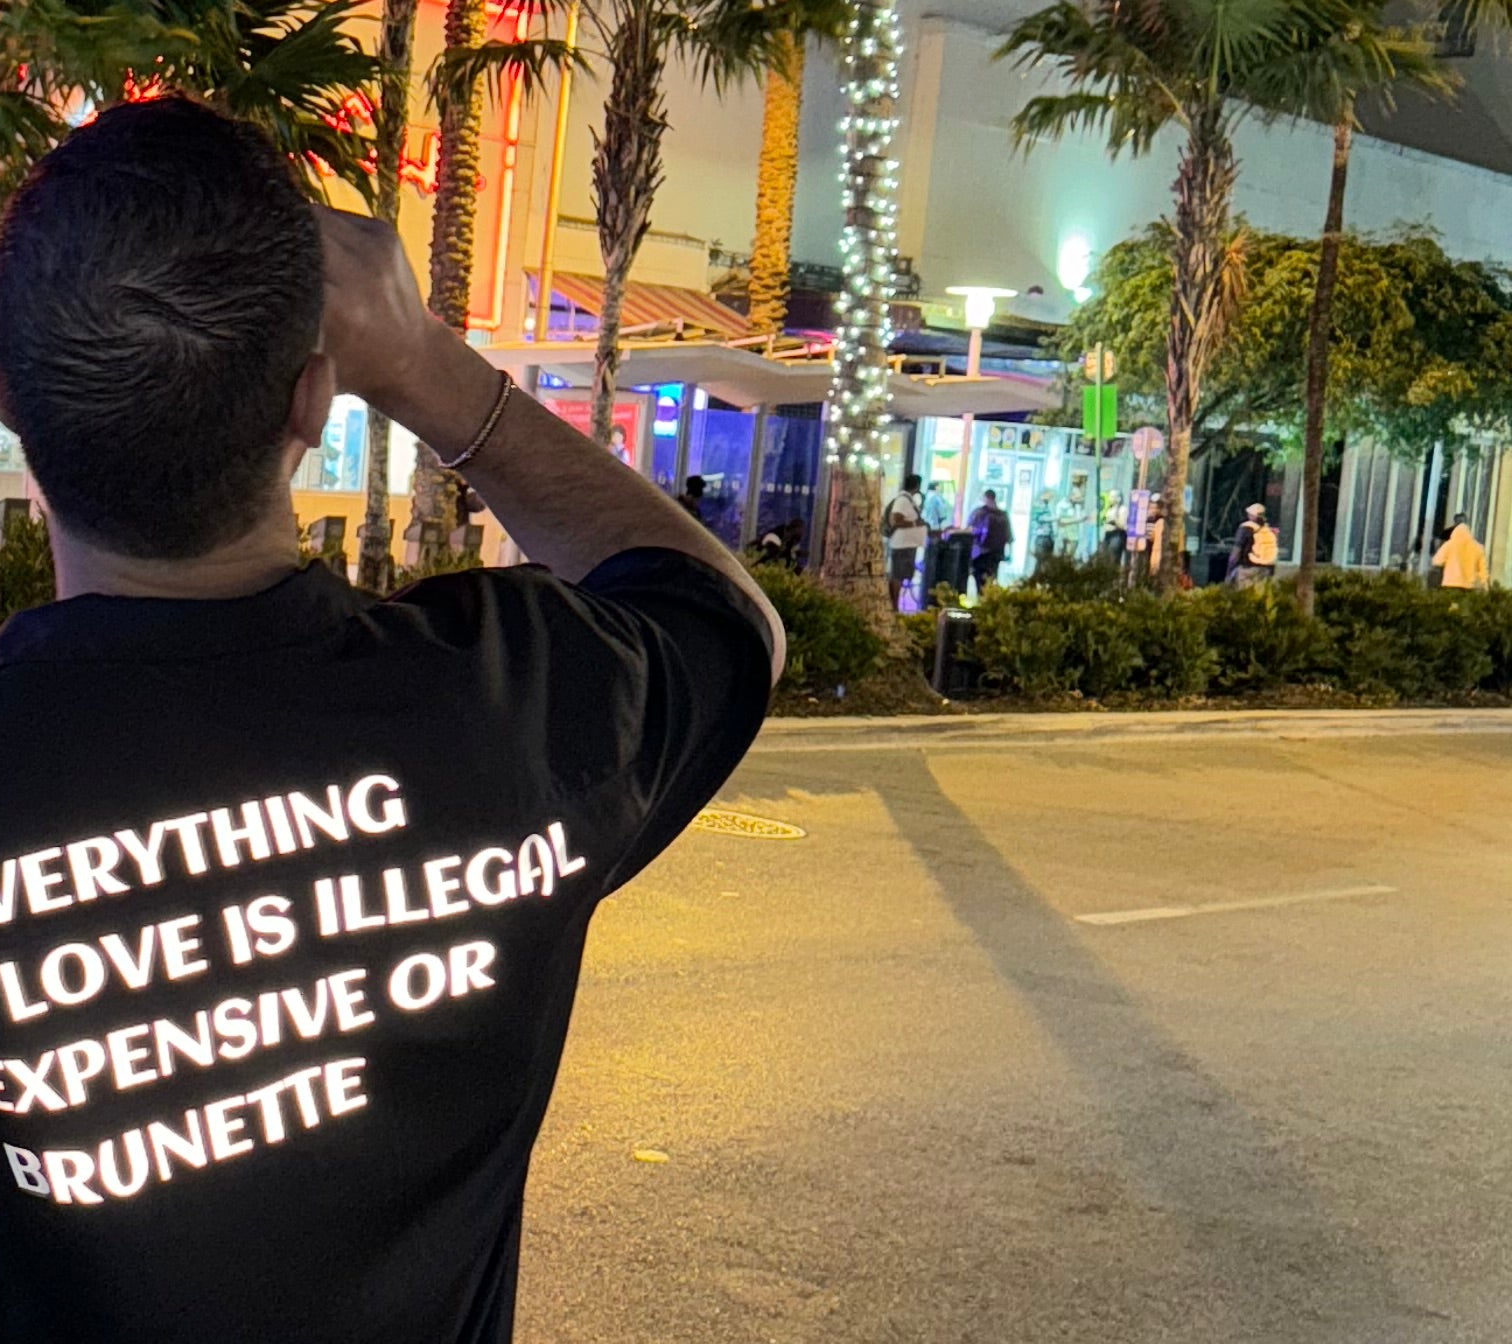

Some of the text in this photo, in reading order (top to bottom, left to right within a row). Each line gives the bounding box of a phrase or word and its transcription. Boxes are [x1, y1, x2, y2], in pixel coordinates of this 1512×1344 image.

[222, 896, 296, 965] IS
[315, 821, 586, 937] ILLEGAL
[389, 940, 496, 1010] OR
[3, 1057, 368, 1205] BRUNETTE
